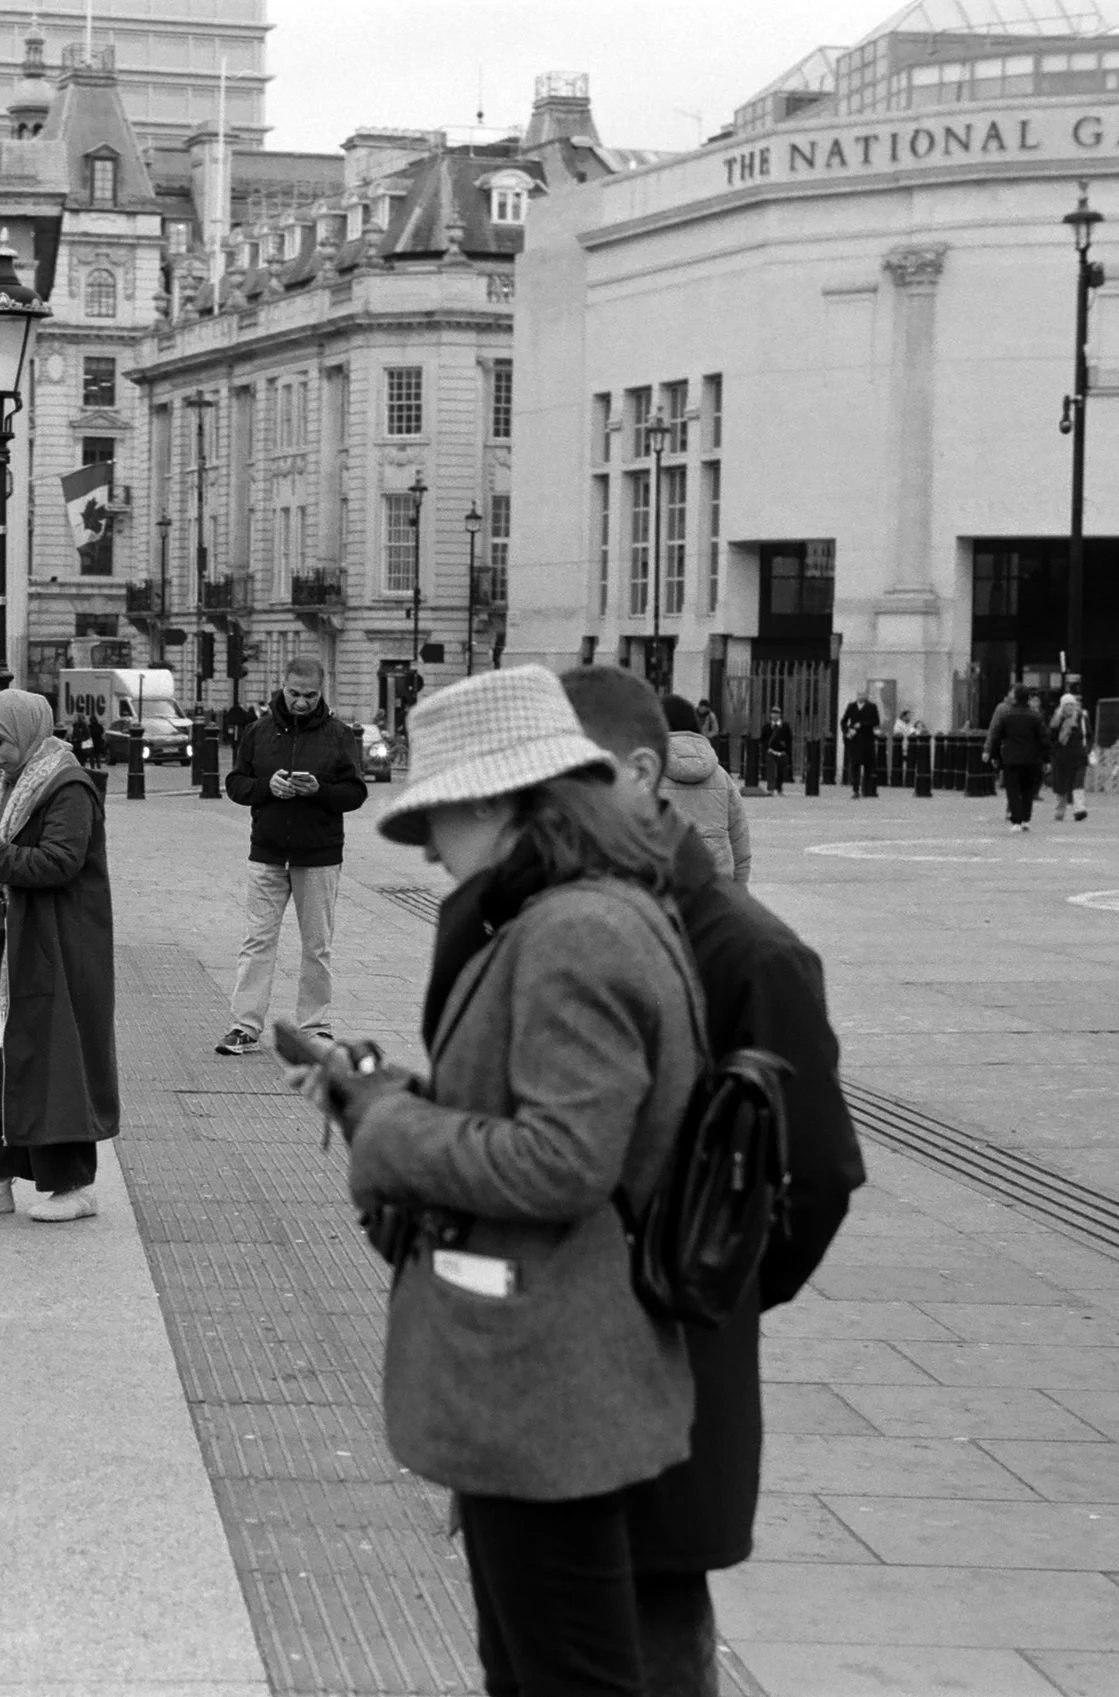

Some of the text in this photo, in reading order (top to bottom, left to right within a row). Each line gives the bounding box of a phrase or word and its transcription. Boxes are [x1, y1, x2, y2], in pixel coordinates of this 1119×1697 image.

[723, 115, 1119, 187] THE NATIONAL G
